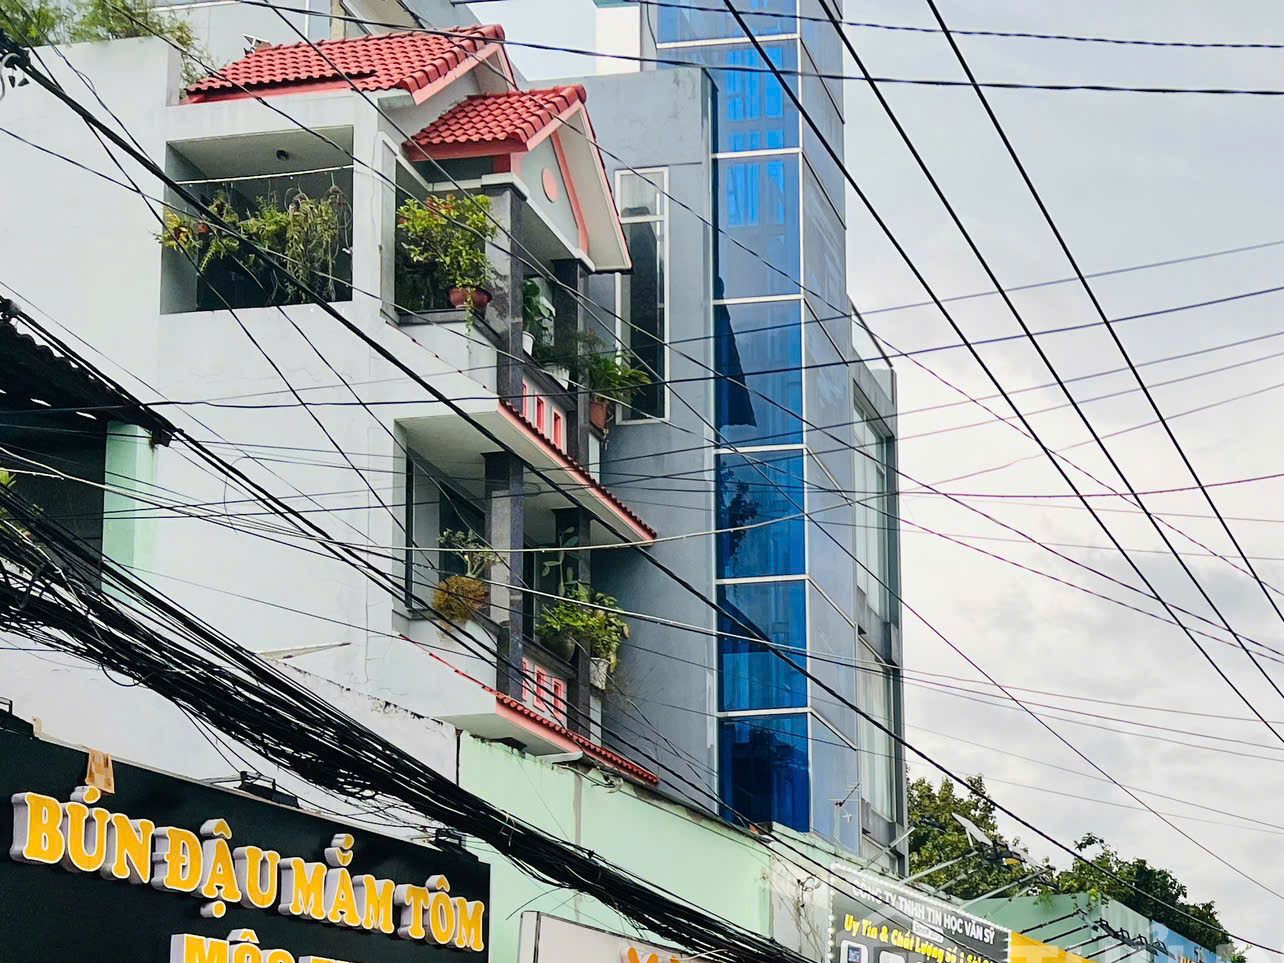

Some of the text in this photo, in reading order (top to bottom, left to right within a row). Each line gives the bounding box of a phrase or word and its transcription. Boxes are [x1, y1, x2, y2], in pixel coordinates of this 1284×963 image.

[10, 785, 485, 952] BÚN ĐẬU MẮM TÔM
[844, 914, 859, 937] Uy
[879, 925, 889, 943] &
[891, 929, 914, 951] Chất
[914, 936, 944, 963] Lượng
[899, 896, 925, 919] TNHH
[927, 905, 942, 926] TIN
[943, 913, 963, 935] HỌC
